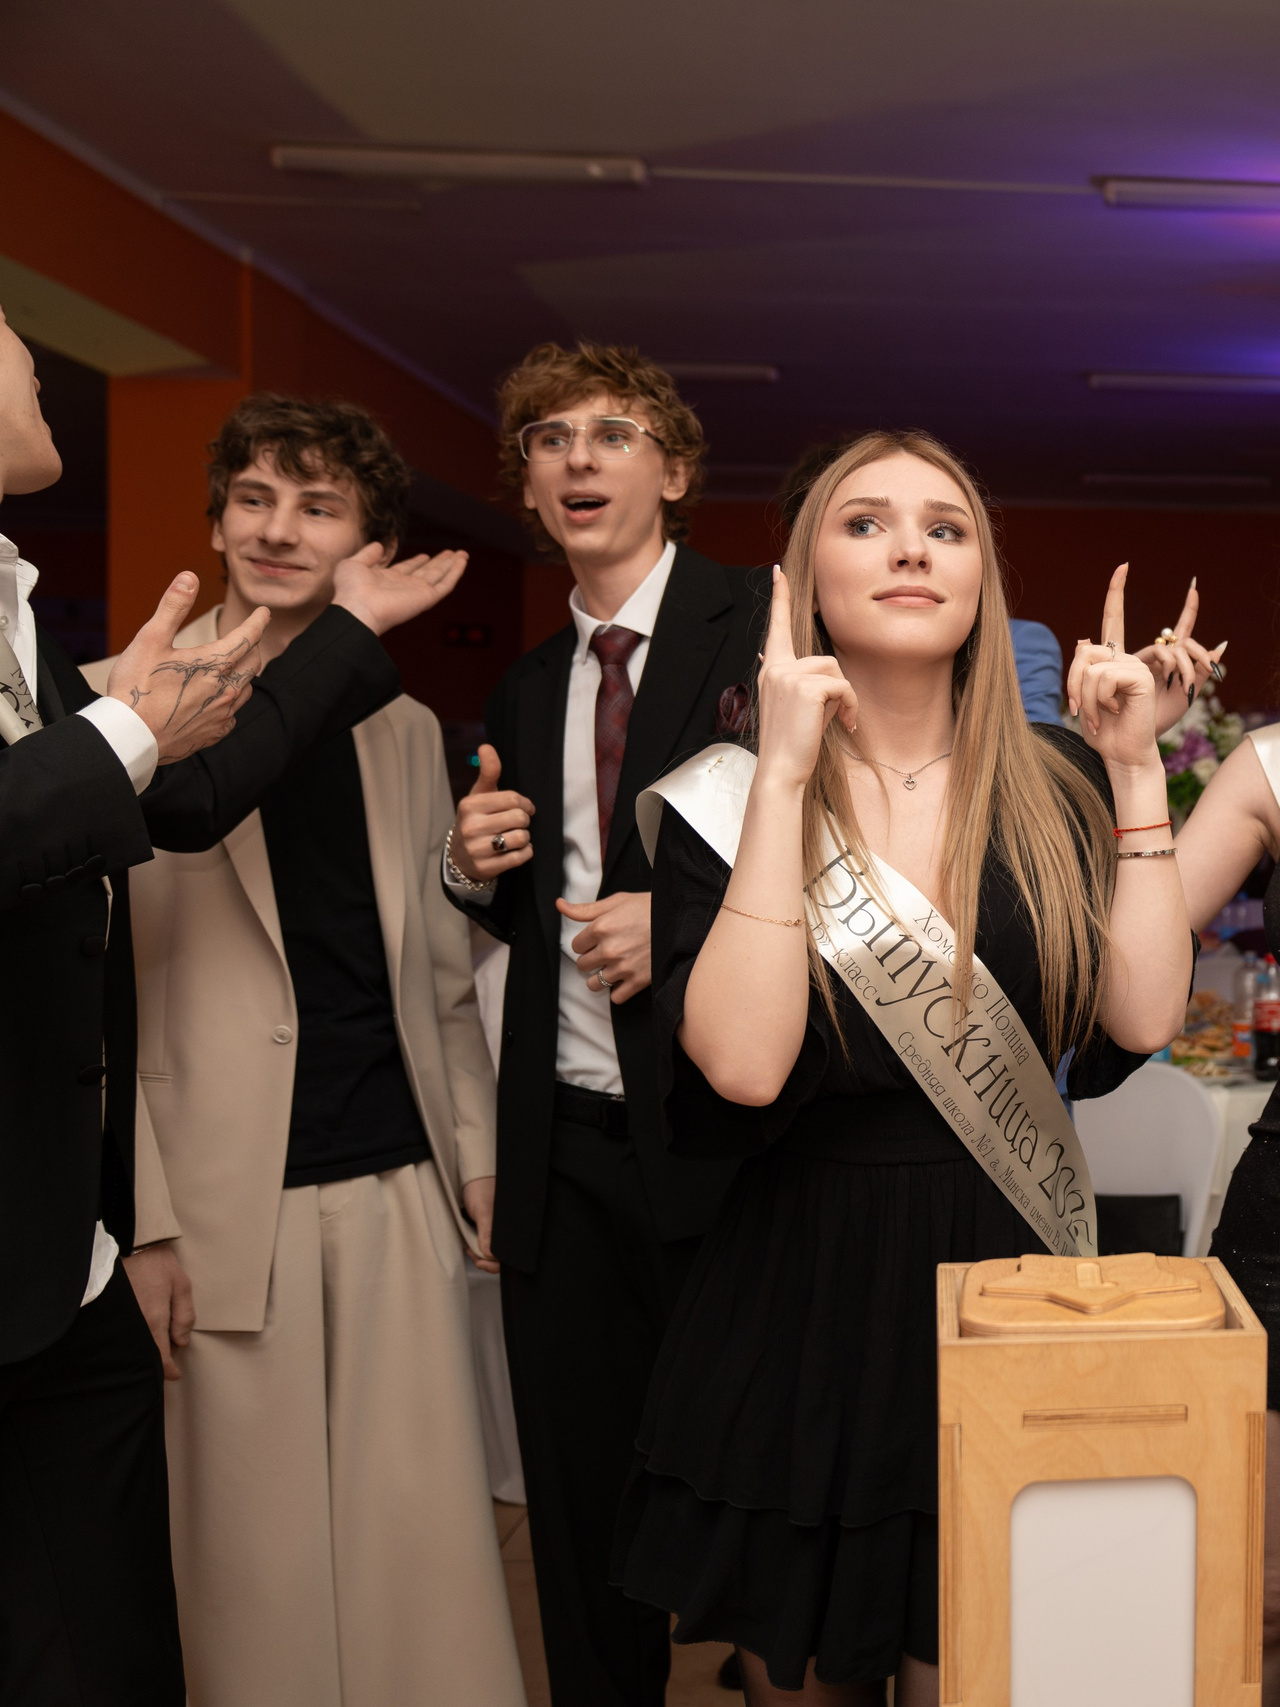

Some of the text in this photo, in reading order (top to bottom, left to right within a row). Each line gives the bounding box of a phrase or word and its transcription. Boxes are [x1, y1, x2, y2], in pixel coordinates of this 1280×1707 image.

[803, 845, 1038, 1172] Выпускница
[832, 948, 877, 1000] класс
[898, 1031, 946, 1097] Средняя
[942, 1097, 975, 1136] школа
[971, 1133, 995, 1159] №1
[999, 1165, 1030, 1210] Минска
[1029, 1206, 1054, 1239] имени
[913, 908, 1030, 1066] Хомко Полина
